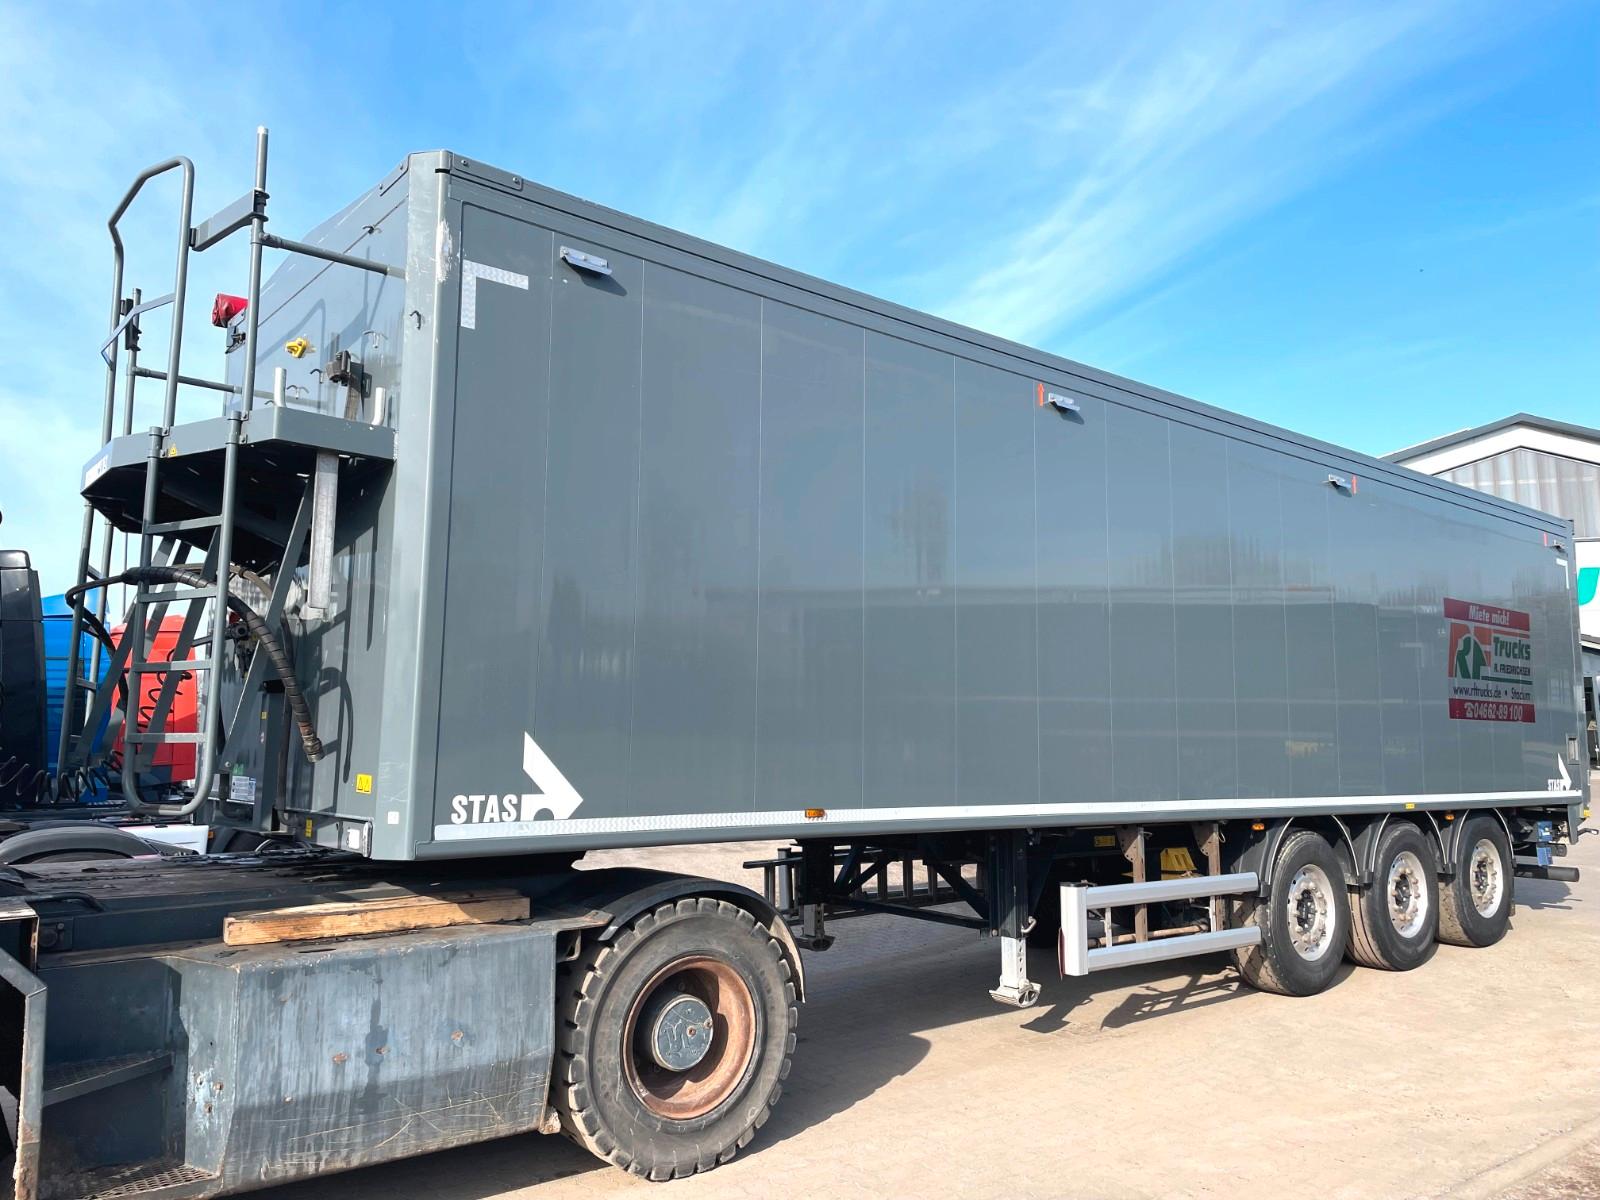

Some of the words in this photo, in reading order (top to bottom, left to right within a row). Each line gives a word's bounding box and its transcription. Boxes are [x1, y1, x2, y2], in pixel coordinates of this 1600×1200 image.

[1469, 605, 1490, 622] Miete
[1492, 610, 1510, 625] mich!
[1494, 637, 1531, 660] Trucks
[1509, 704, 1523, 720] 100
[451, 794, 518, 824] STAS
